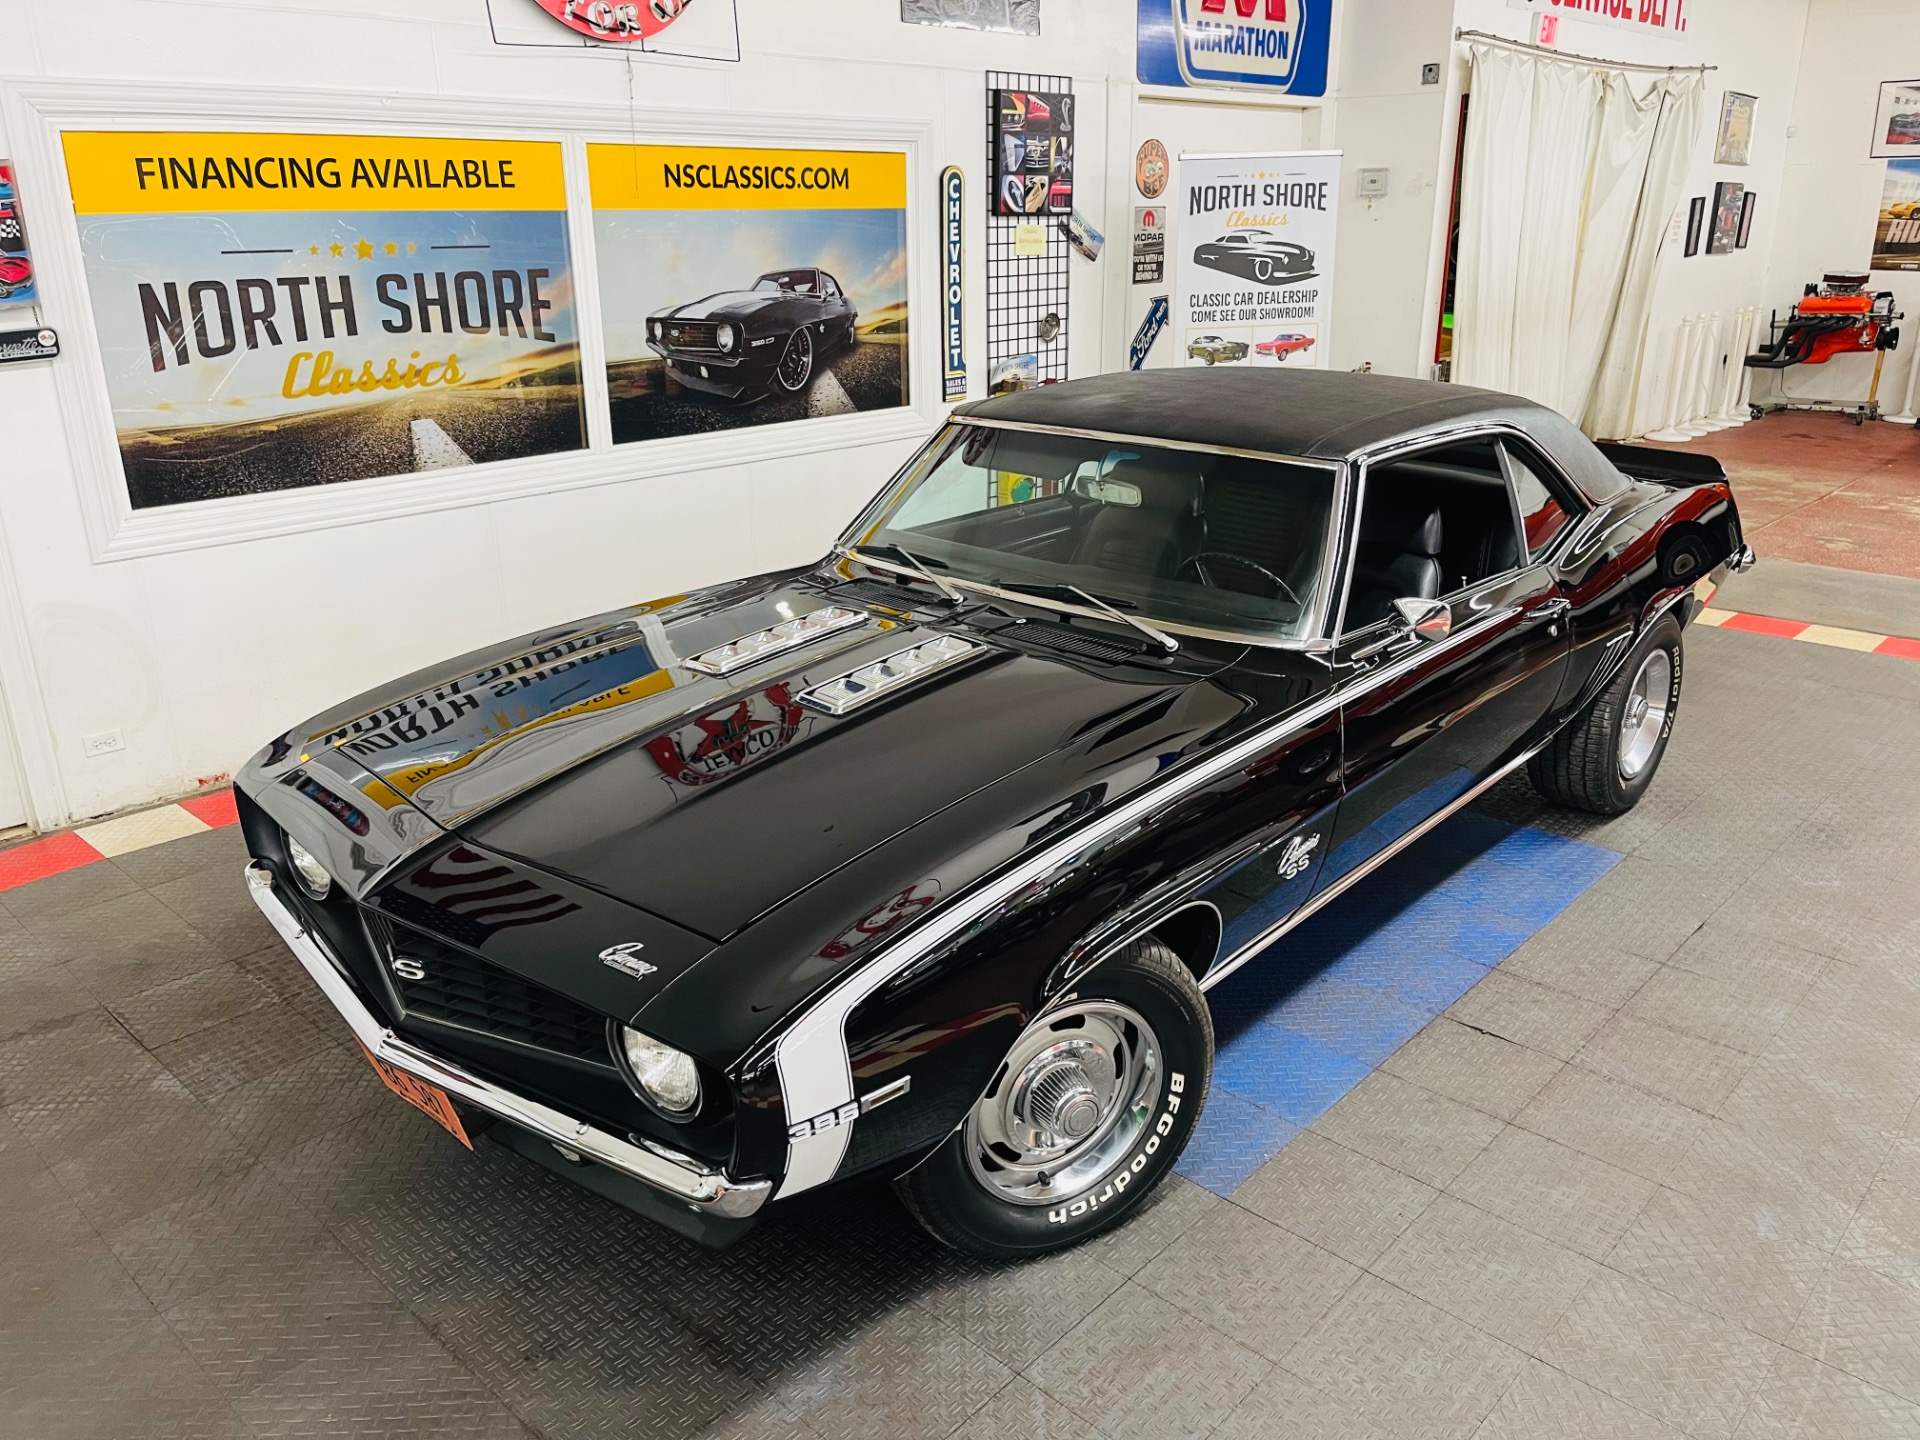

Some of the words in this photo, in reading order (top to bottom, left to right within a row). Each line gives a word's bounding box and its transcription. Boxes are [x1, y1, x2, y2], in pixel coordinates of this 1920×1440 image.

[1194, 21, 1289, 60] MARATHON
[135, 157, 341, 190] FINANCING
[351, 159, 516, 189] AVAILABLE
[663, 164, 849, 190] NSCLASSICS.COM
[1143, 174, 1164, 196] BEE
[1189, 184, 1256, 216] NORTH
[1263, 182, 1328, 212] SHORE
[1225, 211, 1289, 228] Classics
[948, 178, 962, 368] CHEVROLET
[1189, 292, 1231, 308] CLASSIC
[1233, 291, 1254, 306] CAR
[1257, 289, 1319, 306] DEALERSHIP
[1191, 309, 1217, 323] COME
[1219, 309, 1236, 322] SEE
[1238, 308, 1257, 321] OUR
[1259, 306, 1314, 320] SHOWROOM!
[138, 275, 359, 373] NORTH
[376, 268, 556, 343] SHORE
[1136, 316, 1158, 359] Ford
[282, 350, 468, 399] Classics
[1671, 645, 1682, 703] Radial
[1661, 709, 1677, 739] T/A
[1282, 854, 1310, 880] SS
[788, 1100, 860, 1145] 396
[1048, 1071, 1186, 1225] BFGoodrich
